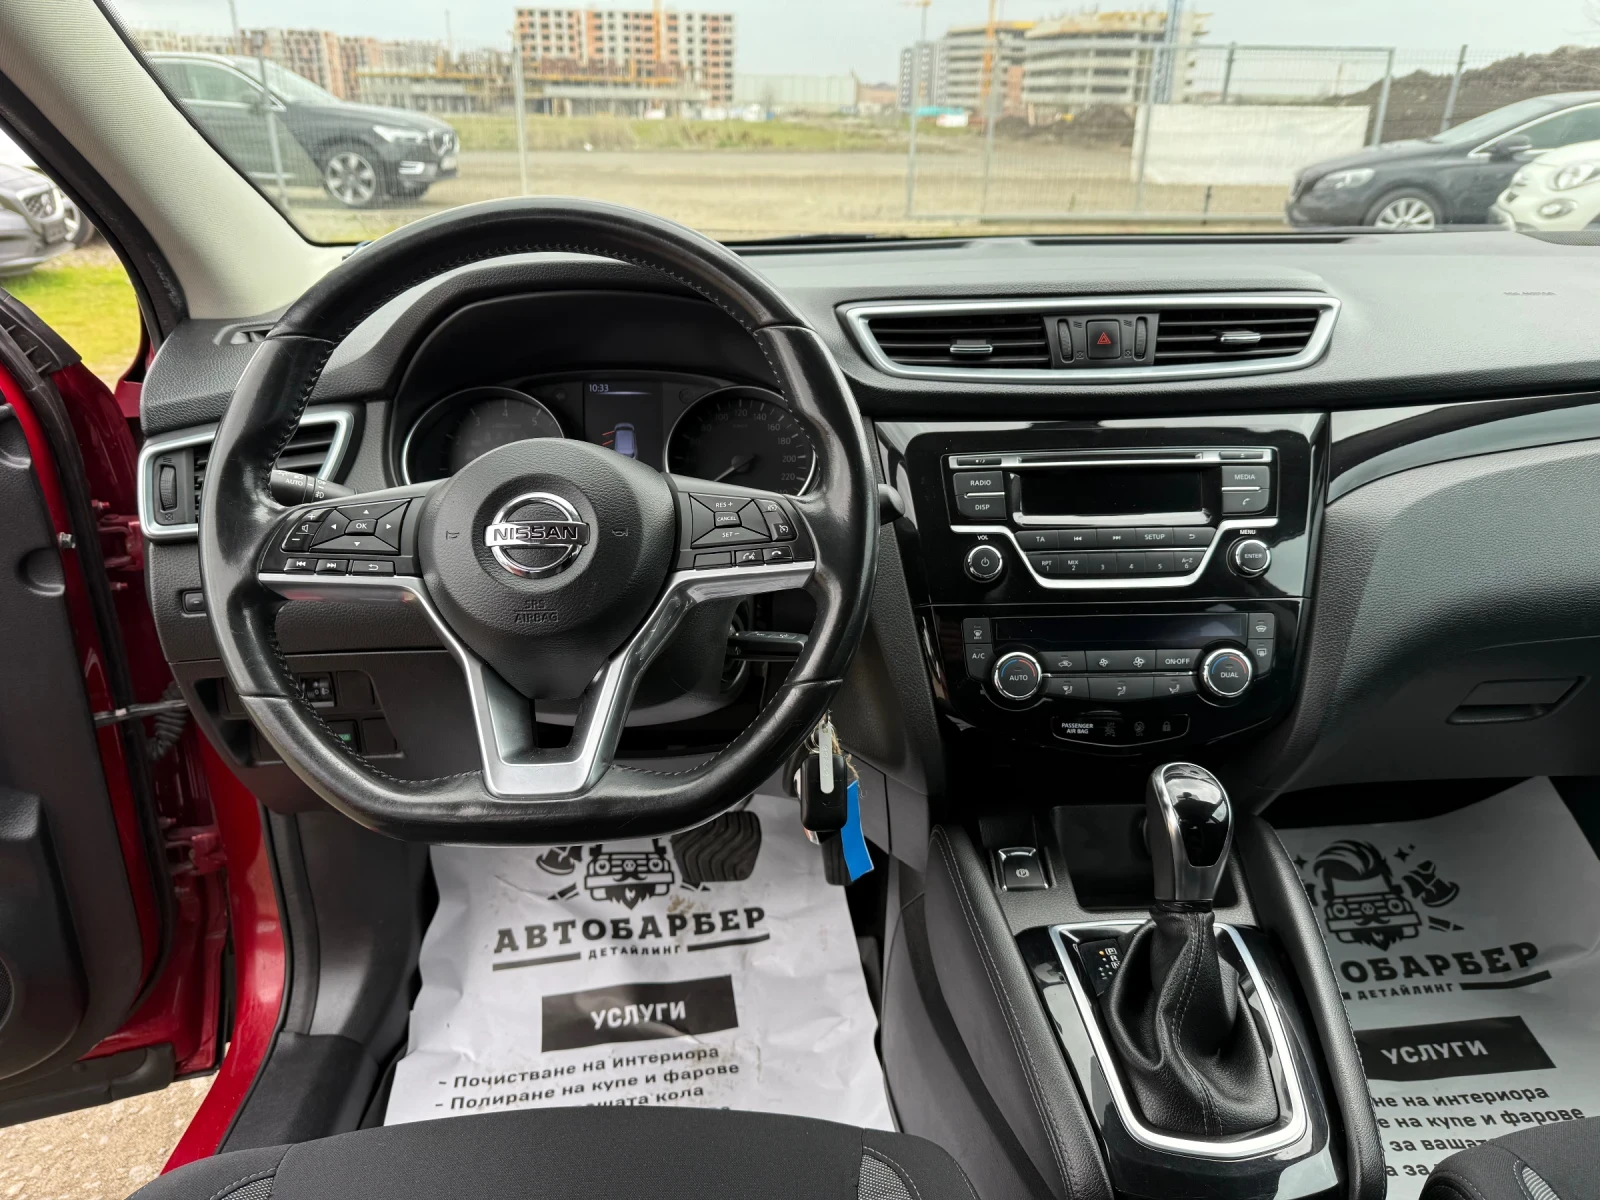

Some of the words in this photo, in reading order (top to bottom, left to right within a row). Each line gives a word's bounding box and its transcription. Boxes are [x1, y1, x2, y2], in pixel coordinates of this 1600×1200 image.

[588, 384, 609, 392] 10:33
[502, 409, 508, 418] 4
[734, 409, 747, 417] 120
[753, 413, 767, 421] 140
[531, 417, 538, 426] 5
[767, 423, 780, 431] 160
[778, 437, 791, 445] 180
[782, 455, 796, 463] 200
[285, 478, 303, 486] AUTO
[781, 473, 795, 481] 220
[493, 525, 578, 542] NISSAN
[523, 600, 547, 610] SRS
[514, 613, 559, 624] AIRBAG
[493, 907, 765, 954] АВТОБАРБЕР
[588, 945, 681, 960] ДЕТАЙЛИНГ
[1340, 942, 1538, 983] ОБАРБЕР
[1357, 983, 1454, 1001] ДЕТАЙЛИНГ
[590, 1001, 686, 1030] УСЛУГИ
[1381, 1039, 1488, 1065] УСЛУГИ
[454, 1065, 576, 1088] Почистване
[583, 1060, 605, 1072] на
[613, 1048, 719, 1068] интериора
[451, 1088, 555, 1110] Полиране
[562, 1082, 585, 1096] на
[592, 1076, 638, 1092] купе
[645, 1074, 656, 1084] и
[664, 1064, 739, 1084] фарове
[656, 1086, 703, 1103] кола
[1402, 1095, 1429, 1107] на
[1432, 1087, 1549, 1106] интериора
[1395, 1115, 1422, 1128] на
[1426, 1115, 1476, 1129] купе
[1480, 1113, 1496, 1126] и
[1499, 1108, 1585, 1126] фарове
[1389, 1140, 1416, 1152] за
[1403, 1164, 1430, 1176] за
